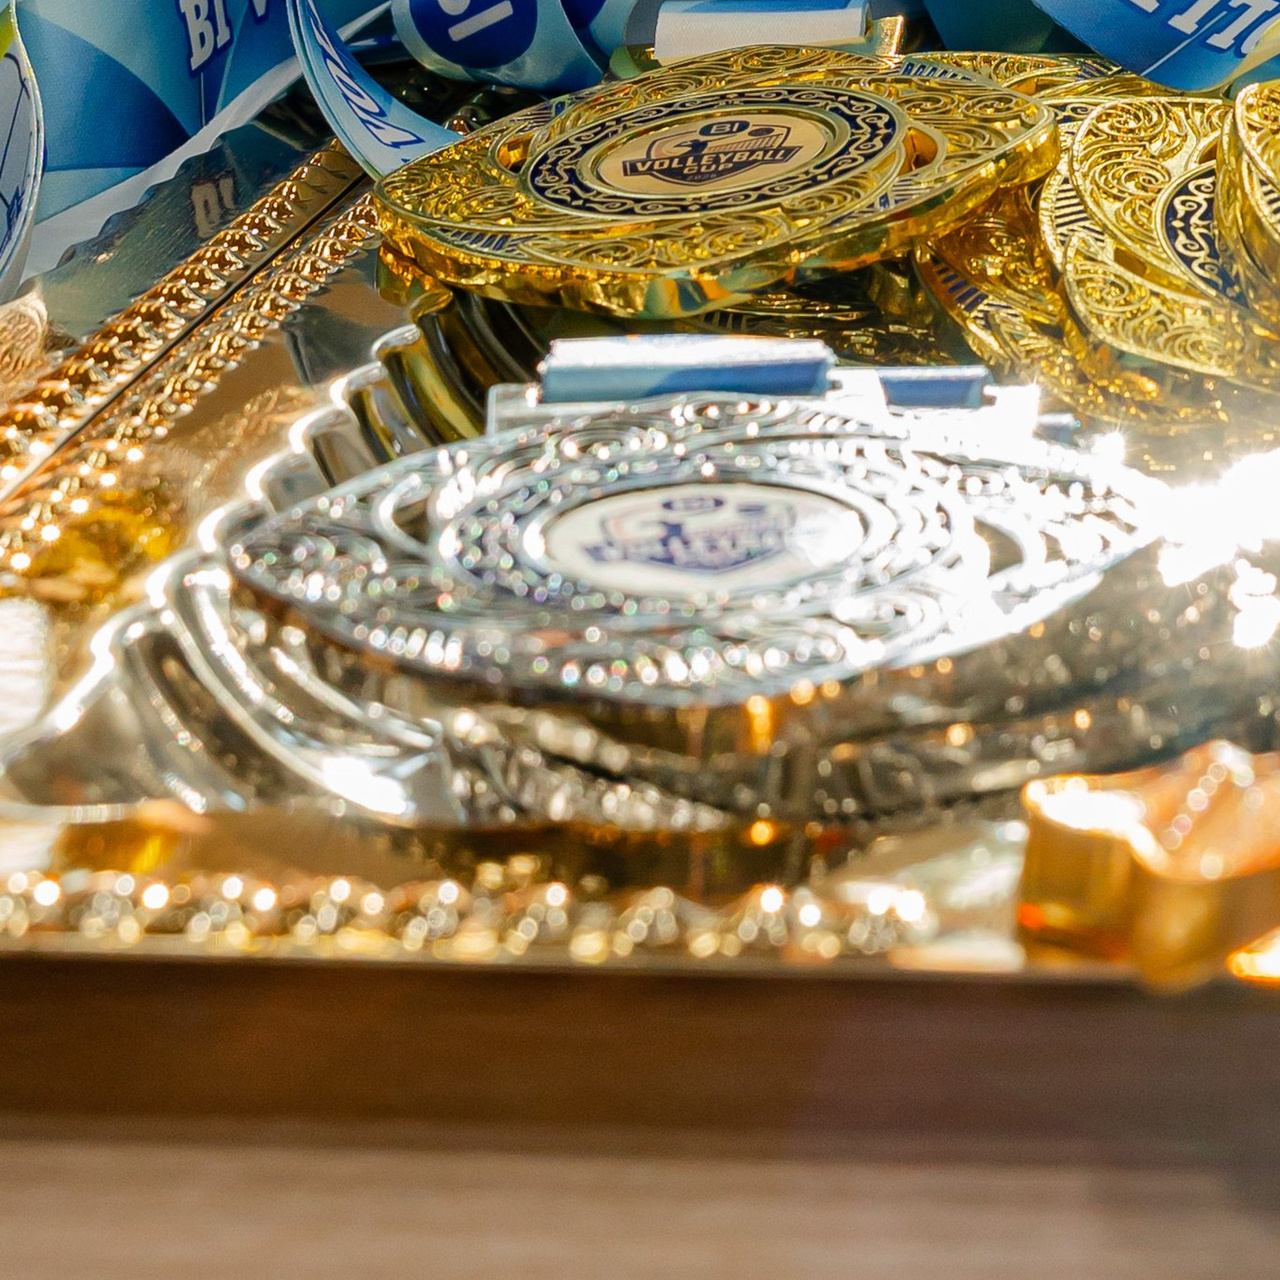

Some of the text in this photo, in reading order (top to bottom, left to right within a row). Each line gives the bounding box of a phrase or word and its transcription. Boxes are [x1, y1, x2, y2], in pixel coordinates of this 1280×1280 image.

[710, 122, 740, 134] BI
[635, 149, 785, 172] VOLLEYBALL
[682, 162, 734, 175] CUP
